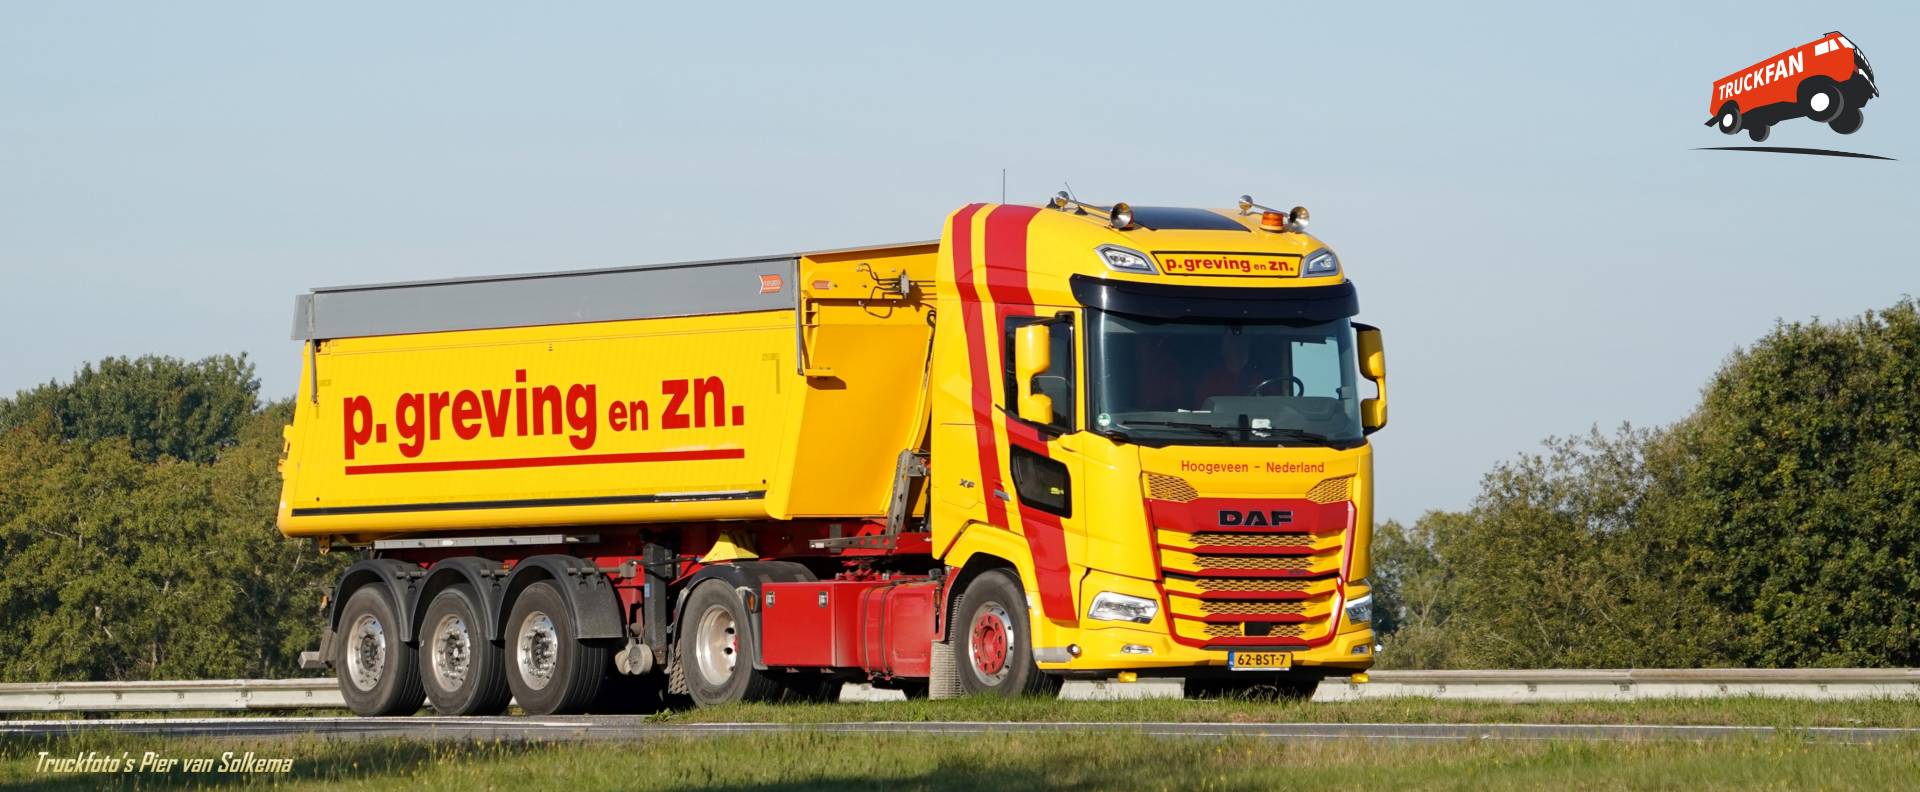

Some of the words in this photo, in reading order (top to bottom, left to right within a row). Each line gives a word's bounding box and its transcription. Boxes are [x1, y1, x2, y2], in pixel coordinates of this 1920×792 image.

[1254, 263, 1267, 271] en
[1269, 261, 1294, 272] zn.
[608, 400, 649, 432] en
[662, 375, 744, 430] zn.
[1181, 460, 1249, 475] Hoogeveen
[1266, 461, 1325, 473] Nederland
[1218, 510, 1293, 527] DAF
[1238, 654, 1286, 666] 62-BST-7
